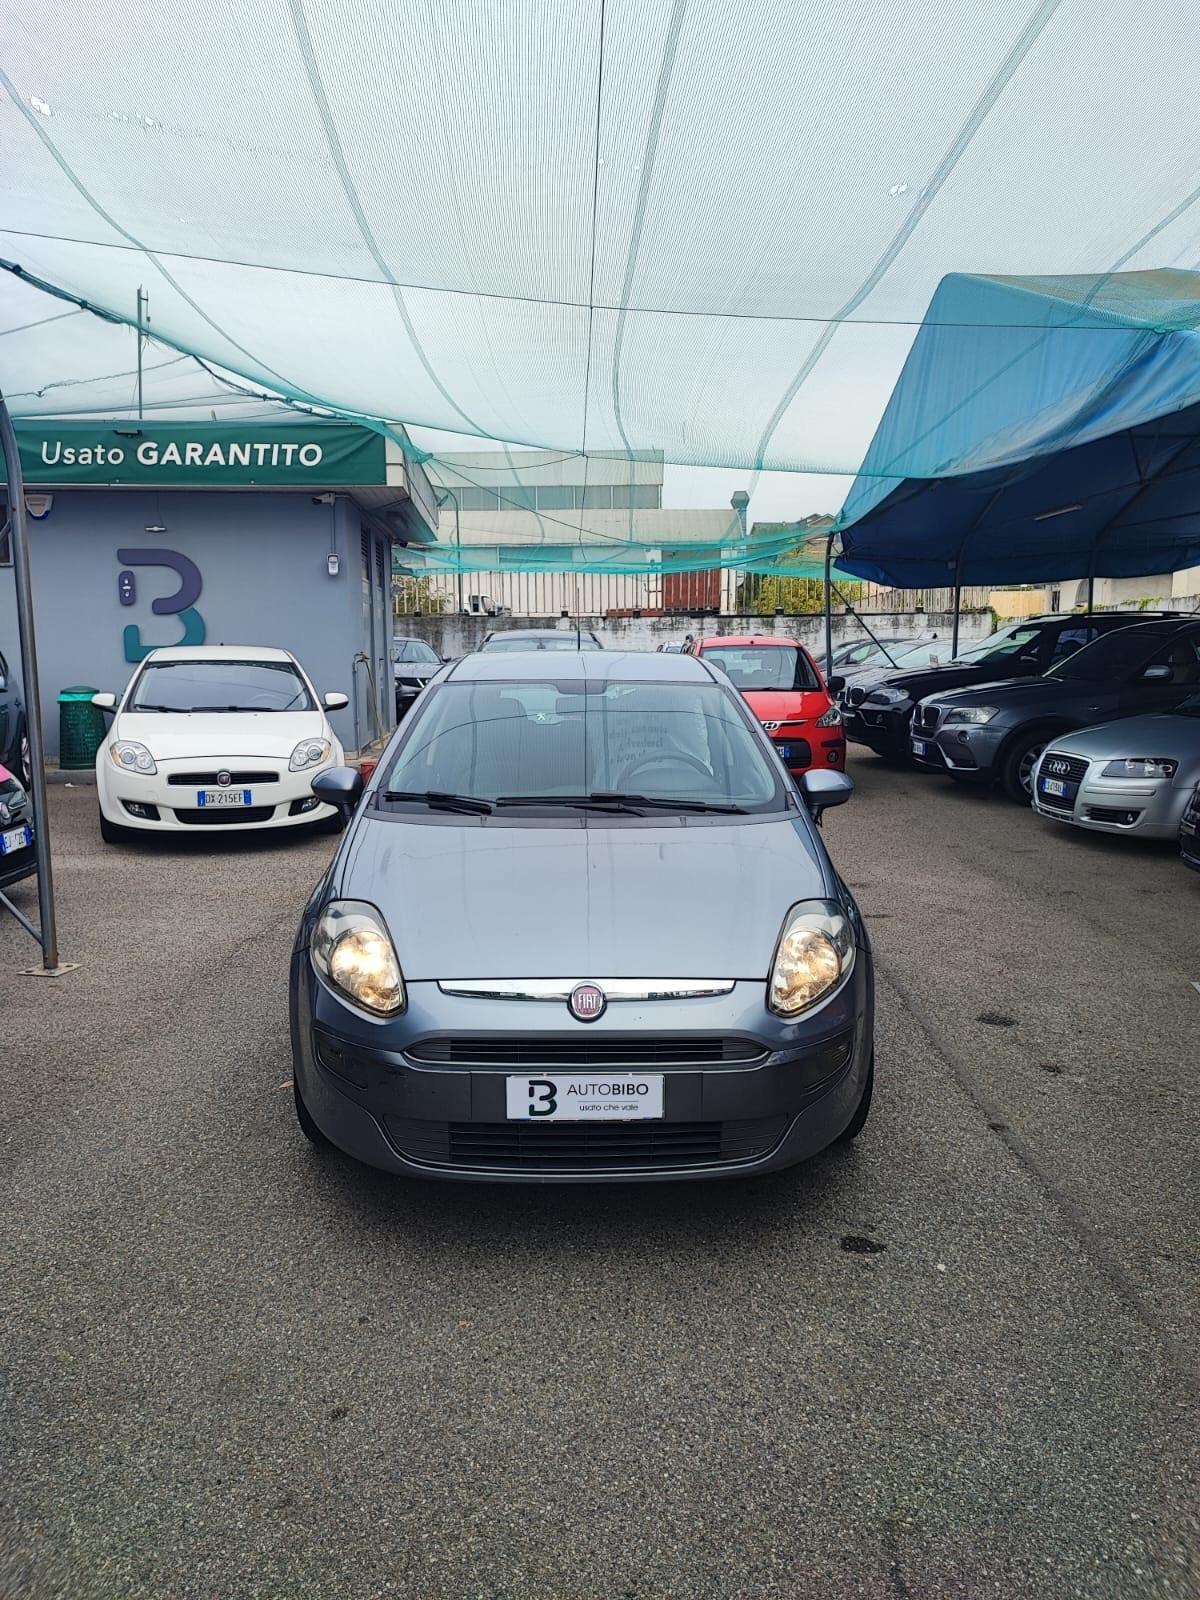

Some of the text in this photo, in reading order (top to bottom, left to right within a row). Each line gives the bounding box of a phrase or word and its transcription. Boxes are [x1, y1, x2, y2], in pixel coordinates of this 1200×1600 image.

[41, 441, 323, 467] Usato GARANTITO
[578, 993, 598, 1009] FIAT
[566, 1083, 649, 1096] AUTOBIBO
[579, 1103, 639, 1112] usato che vale
